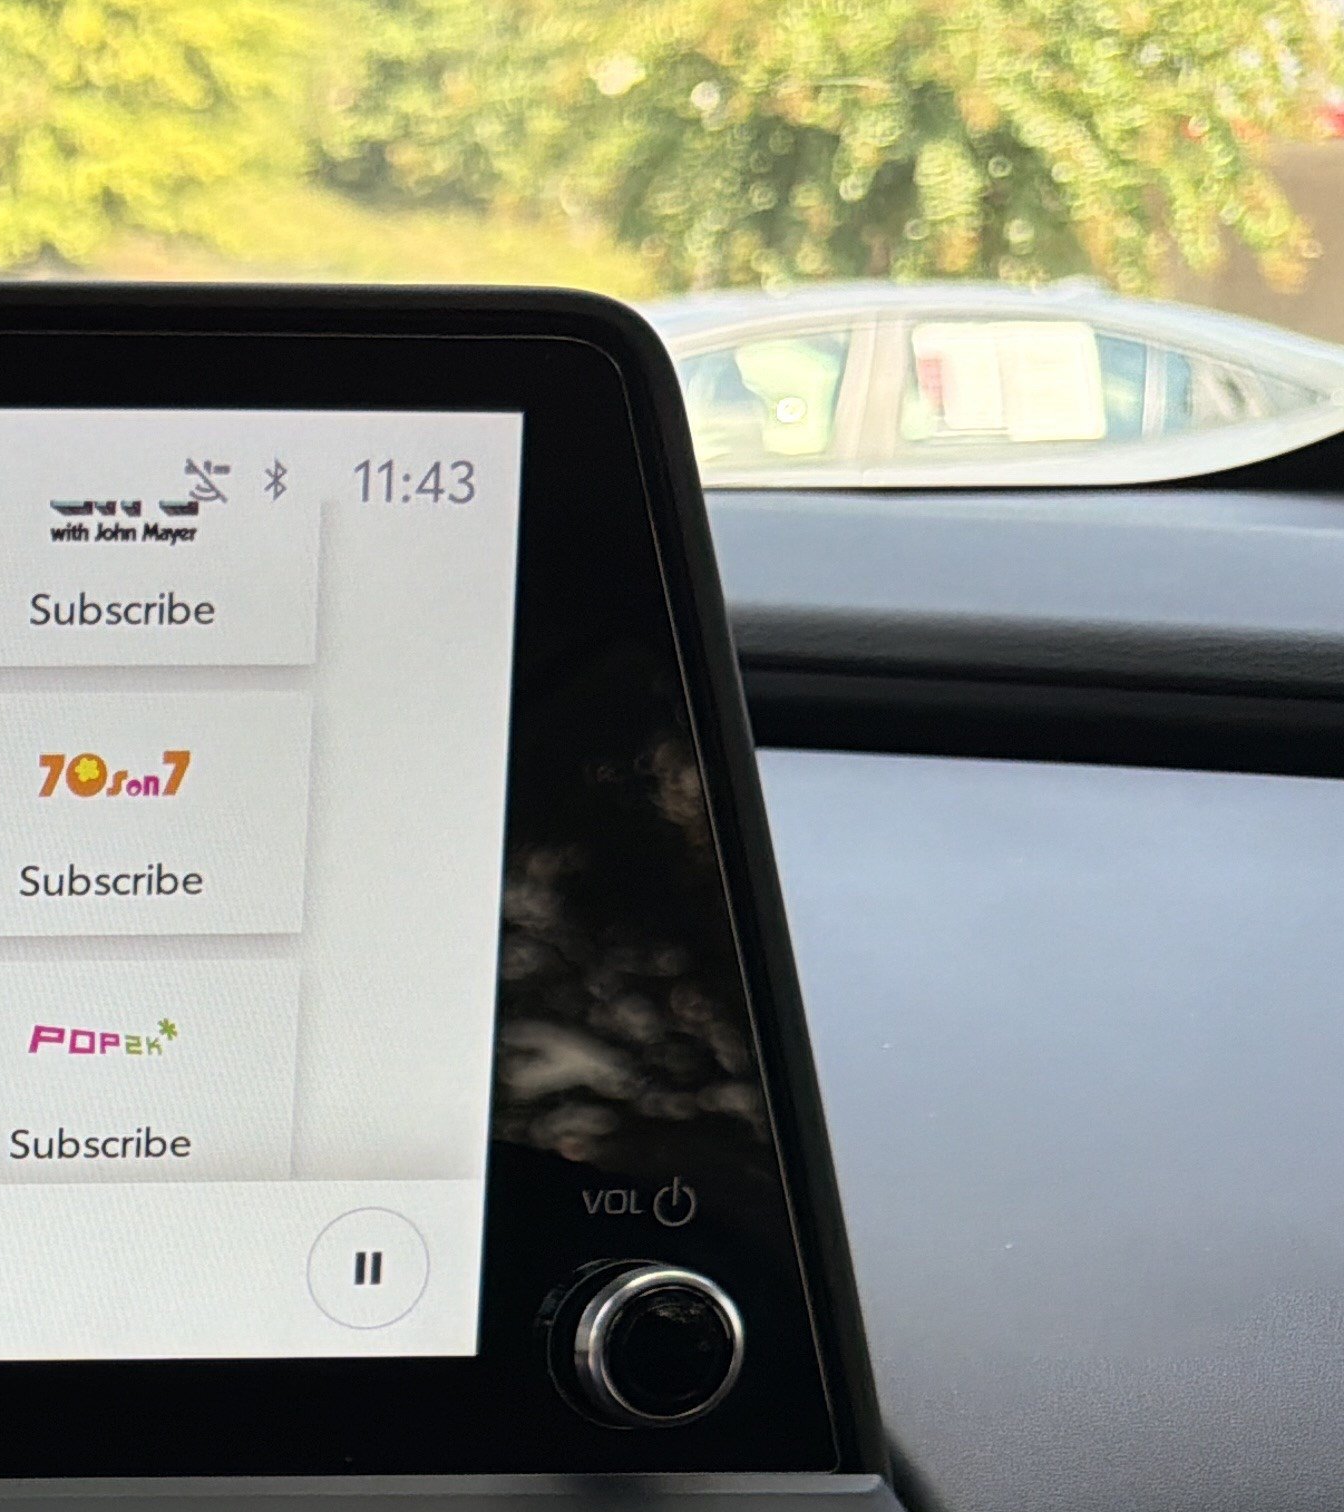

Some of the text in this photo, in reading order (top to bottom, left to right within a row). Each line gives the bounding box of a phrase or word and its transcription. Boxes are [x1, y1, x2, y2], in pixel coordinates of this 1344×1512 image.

[354, 459, 477, 503] 11:43
[50, 522, 198, 546] with John Mayer
[29, 591, 216, 625] Subscribe
[19, 863, 203, 896] Subscribe
[10, 1126, 191, 1159] Subscribe
[581, 1189, 645, 1215] VOL
